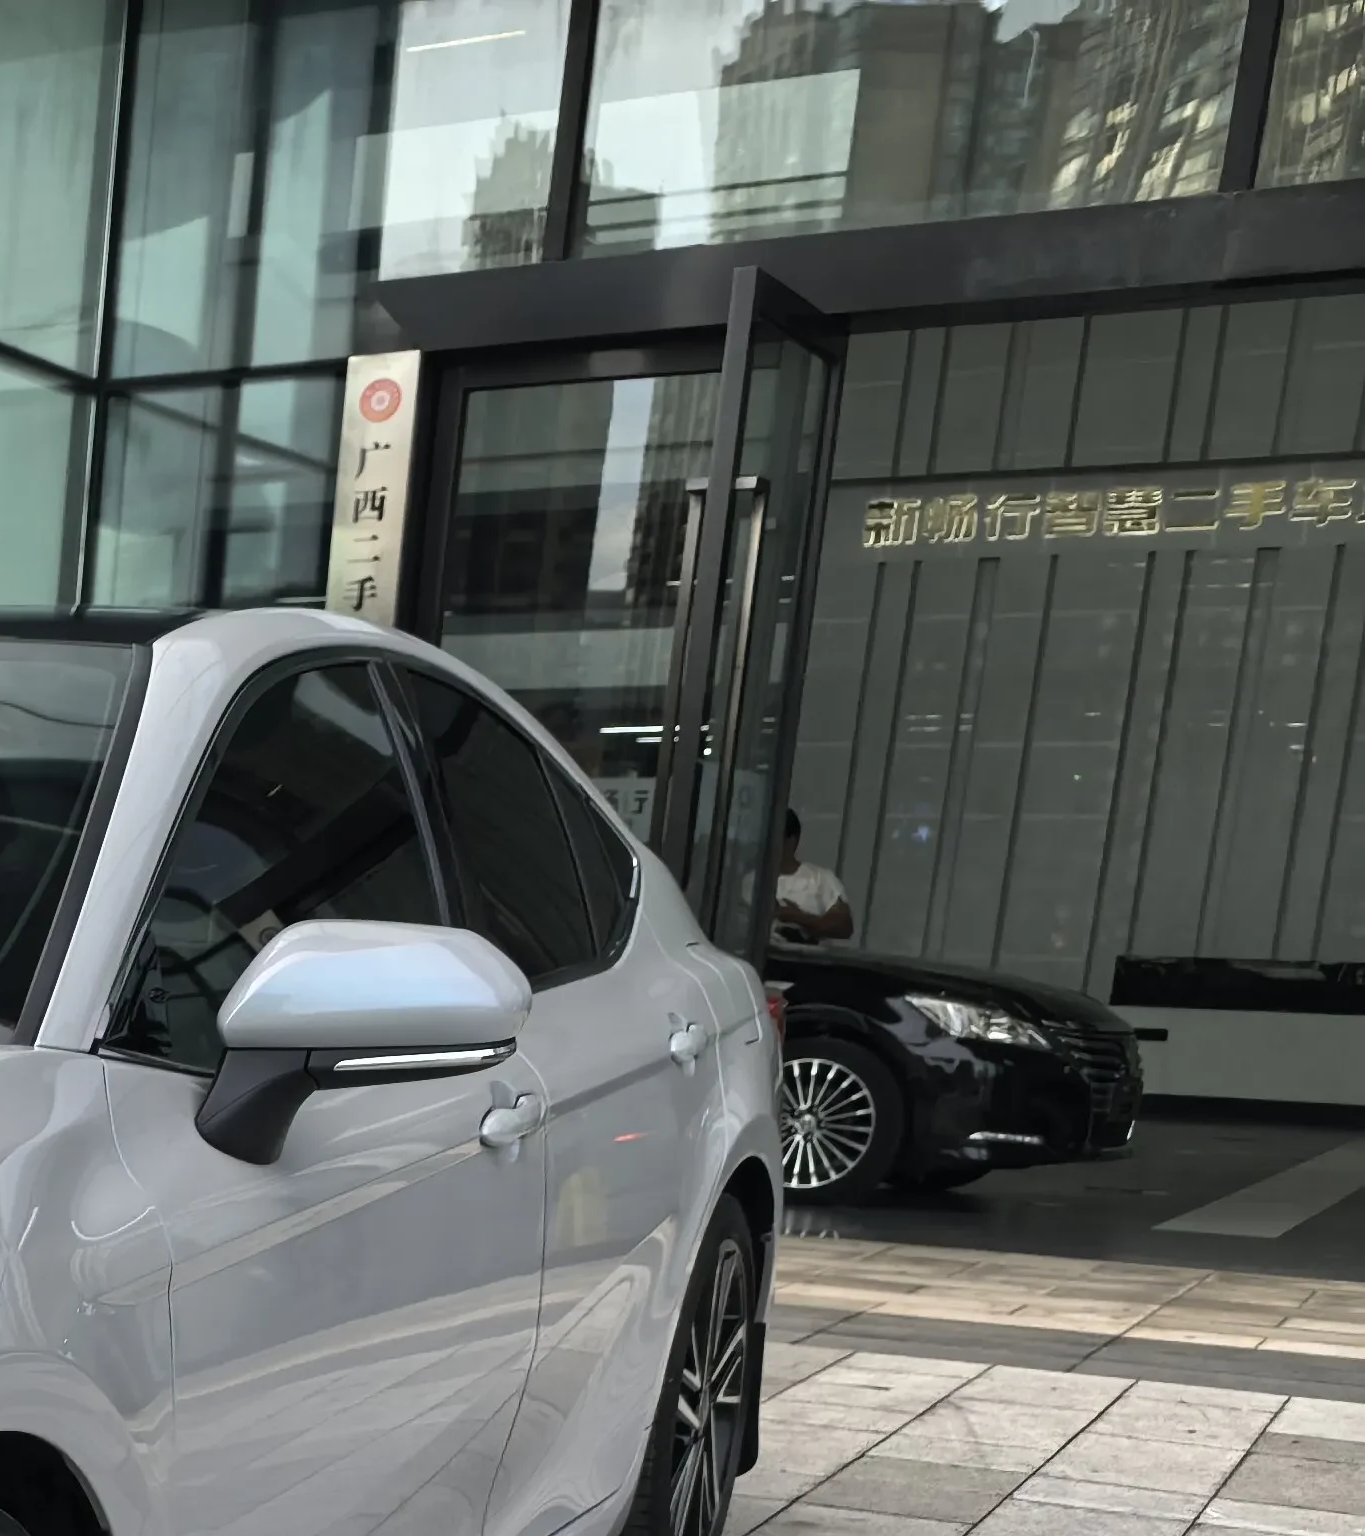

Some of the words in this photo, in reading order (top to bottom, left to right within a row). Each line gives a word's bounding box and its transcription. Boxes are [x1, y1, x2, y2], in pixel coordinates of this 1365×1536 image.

[343, 441, 392, 612] 广西二手
[862, 477, 1365, 548] 新畅行智慧二手车
